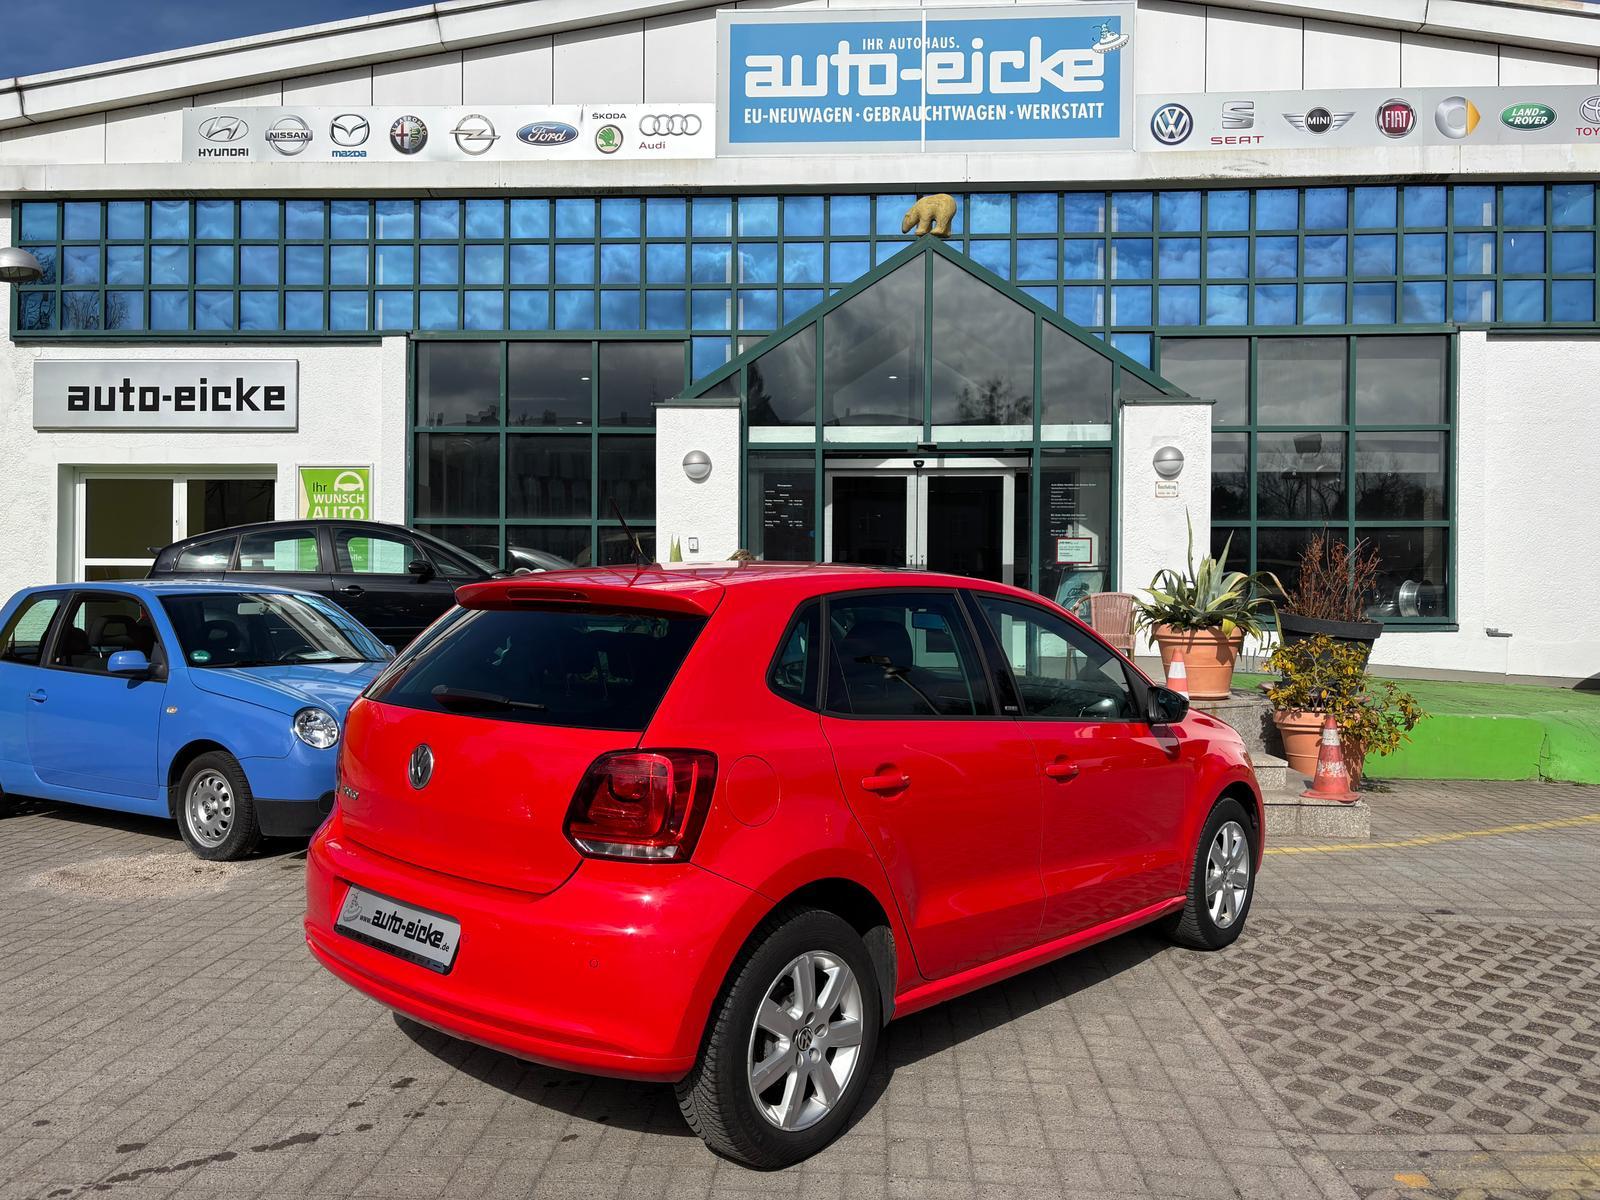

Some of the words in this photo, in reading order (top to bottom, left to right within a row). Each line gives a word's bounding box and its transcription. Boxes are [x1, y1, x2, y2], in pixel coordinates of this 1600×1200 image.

[862, 38, 884, 51] IHR
[889, 36, 960, 50] AUTOHAUS.
[745, 36, 1105, 98] auto-eicke
[744, 107, 853, 124] EU-NEUWAGEN
[862, 104, 1007, 122] GEBRAUCHTWAGEN
[1017, 102, 1105, 120] WERKSTATT
[1512, 108, 1539, 117] LAND
[1308, 116, 1331, 125] MINI
[1385, 110, 1408, 128] FIAT
[1514, 116, 1548, 125] ROVER
[269, 131, 309, 140] NISSAN
[528, 125, 567, 143] Ford
[639, 141, 666, 150] Audi
[1211, 136, 1265, 145] SEAT
[198, 148, 249, 157] HYUNDAI
[68, 378, 285, 412] auto-eicke
[313, 482, 327, 492] Ihr
[313, 494, 365, 504] WUNSCH
[313, 506, 365, 519] AUTO
